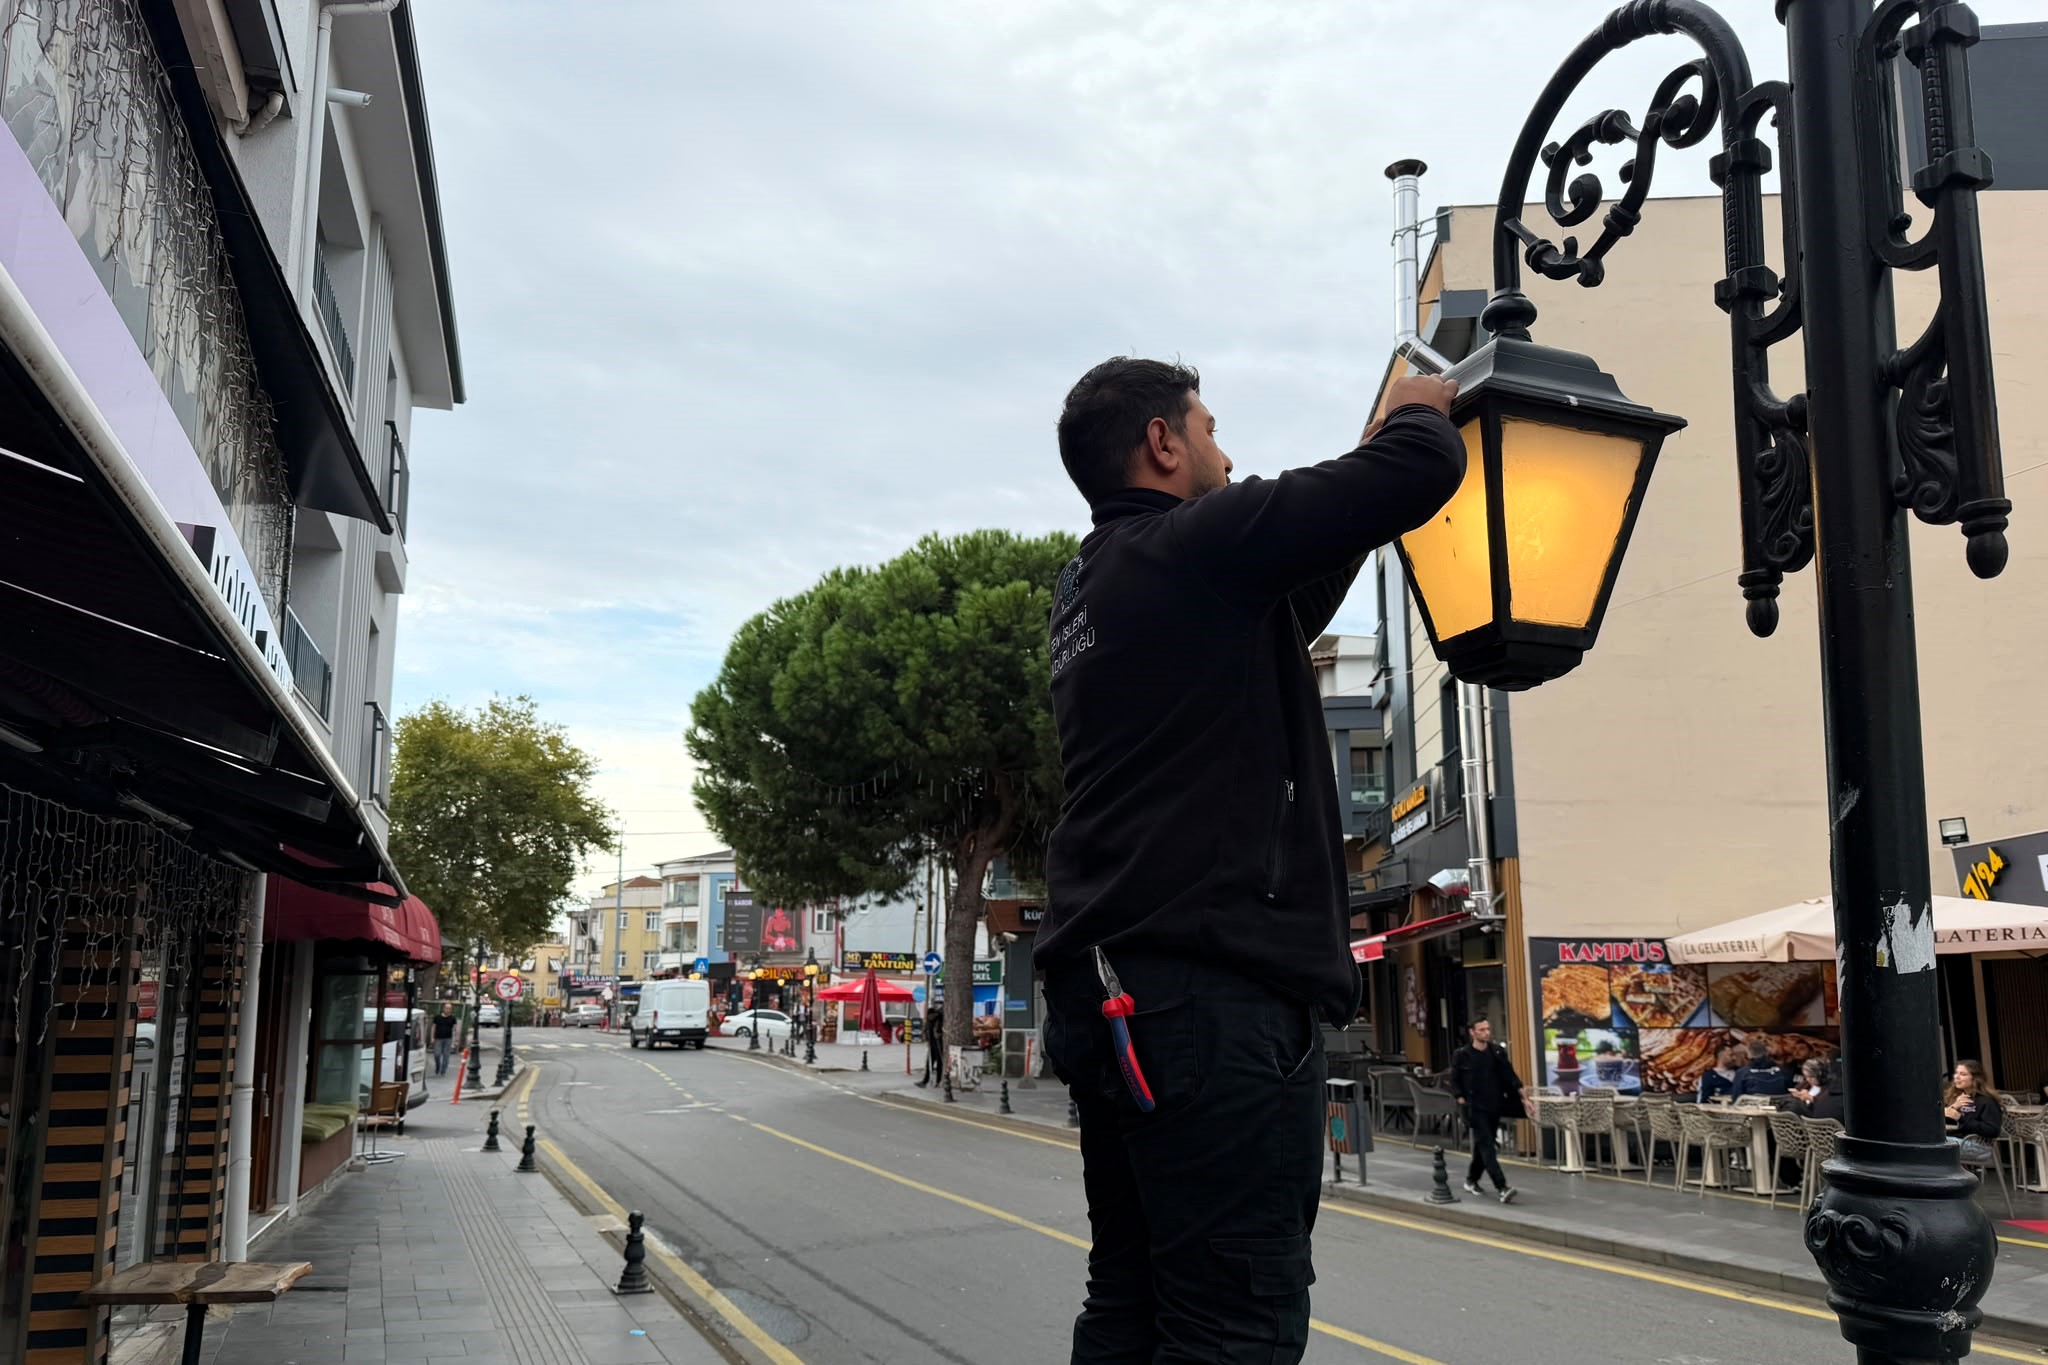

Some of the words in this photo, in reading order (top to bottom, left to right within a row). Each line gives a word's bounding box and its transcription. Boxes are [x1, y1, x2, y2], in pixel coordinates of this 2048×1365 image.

[1062, 604, 1087, 644] İŞLERİ
[1963, 847, 2004, 901] 7/24
[1933, 927, 2047, 944] LATERIA
[1558, 938, 1665, 962] KAMPÜS
[1685, 944, 1697, 956] LA
[1698, 939, 1759, 955] GELATERIA
[871, 952, 906, 961] MEGA
[972, 963, 991, 972] ENÇ
[972, 972, 992, 981] EKEL
